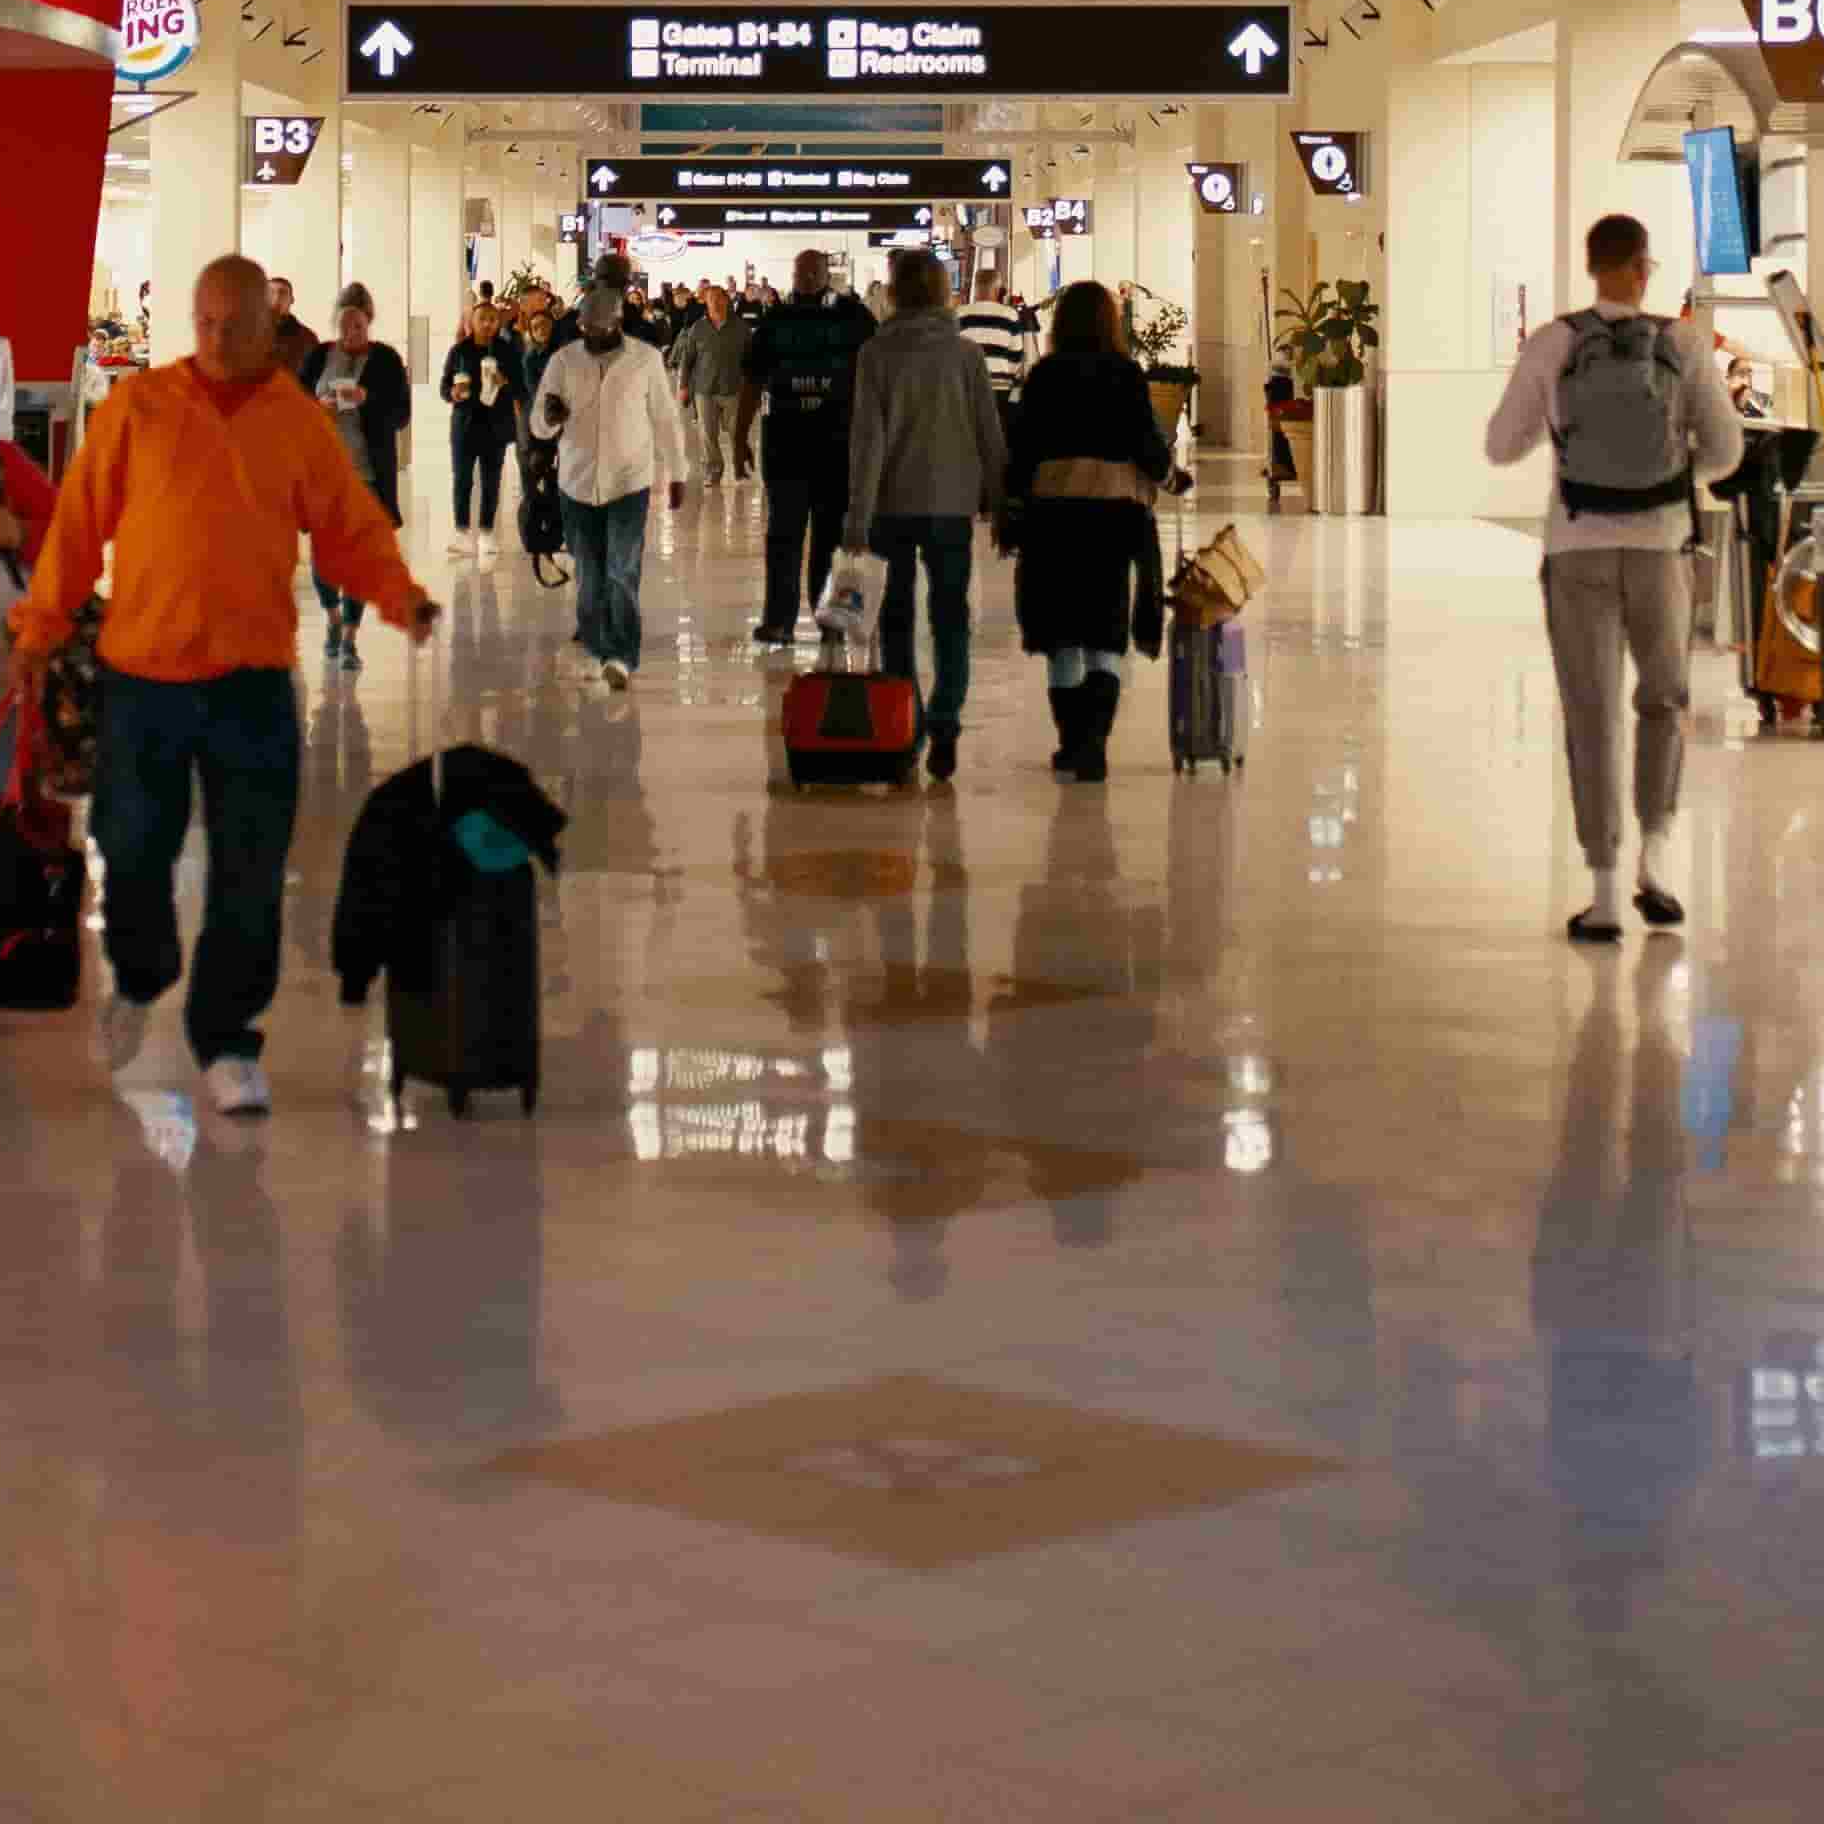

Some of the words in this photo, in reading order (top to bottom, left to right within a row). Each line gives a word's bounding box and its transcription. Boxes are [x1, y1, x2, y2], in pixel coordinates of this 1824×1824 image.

[126, 8, 186, 49] ING
[661, 22, 734, 47] Gates
[737, 22, 812, 47] B1-B4
[859, 22, 909, 52] Bag
[911, 22, 981, 47] Claim
[662, 52, 763, 76] Terminal
[859, 51, 987, 75] Restrooms
[254, 118, 311, 155] B3
[1025, 208, 1055, 226] B2
[1054, 200, 1087, 221] B4
[561, 214, 585, 232] B1
